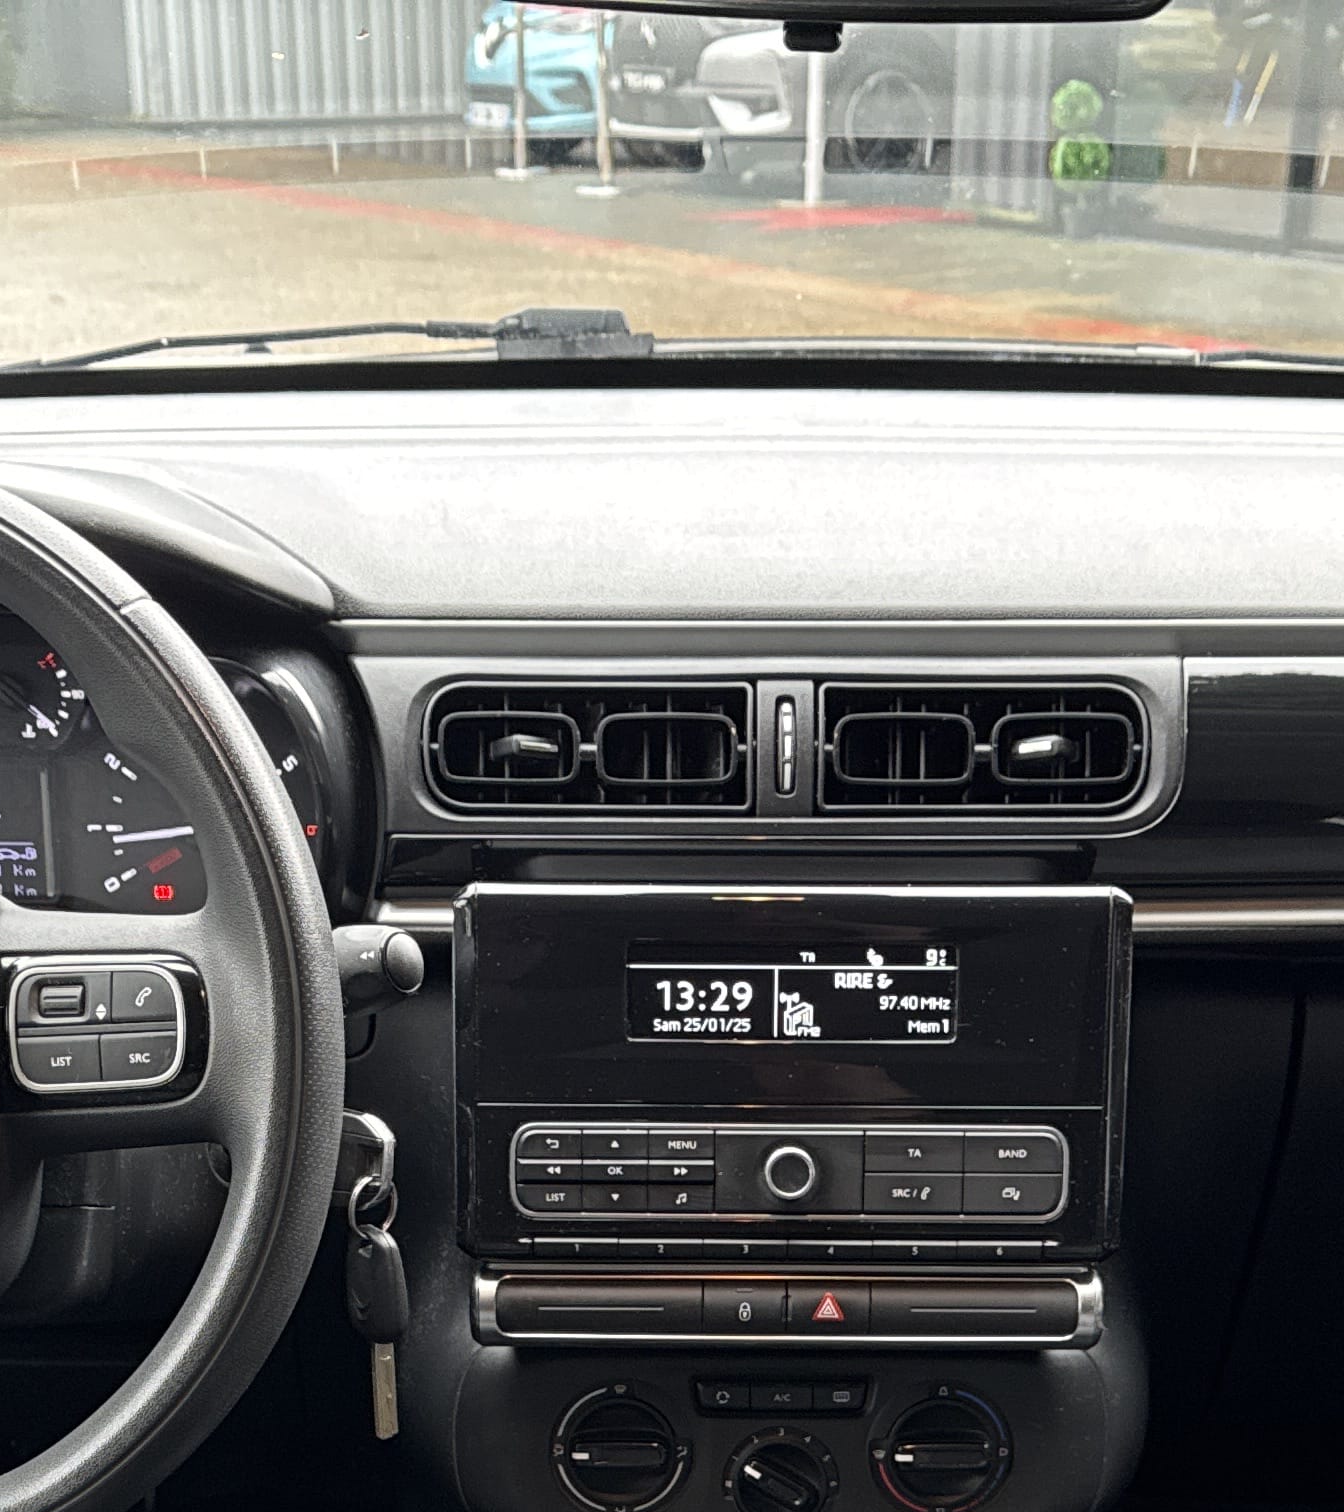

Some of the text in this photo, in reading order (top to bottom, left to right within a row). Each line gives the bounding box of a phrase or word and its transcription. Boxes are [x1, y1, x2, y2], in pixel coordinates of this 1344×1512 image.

[104, 752, 121, 770] 2
[282, 755, 298, 772] 5
[834, 972, 874, 989] RIRE
[656, 980, 753, 1012] 13:29
[879, 995, 951, 1011] 97.40 MHz
[653, 1017, 752, 1033] Sam 25/01/25
[907, 1018, 950, 1034] Mem 1
[50, 1055, 73, 1068] LIST
[128, 1053, 152, 1065] SRC
[667, 1139, 698, 1150] MENU
[907, 1148, 923, 1159] TA
[997, 1149, 1028, 1160] BAND
[607, 1166, 625, 1177] OK
[545, 1192, 567, 1203] LIST
[891, 1188, 910, 1199] SRC
[574, 1243, 581, 1253] 1
[657, 1244, 665, 1254] 2
[911, 1247, 919, 1256] 5
[996, 1247, 1004, 1256] 6
